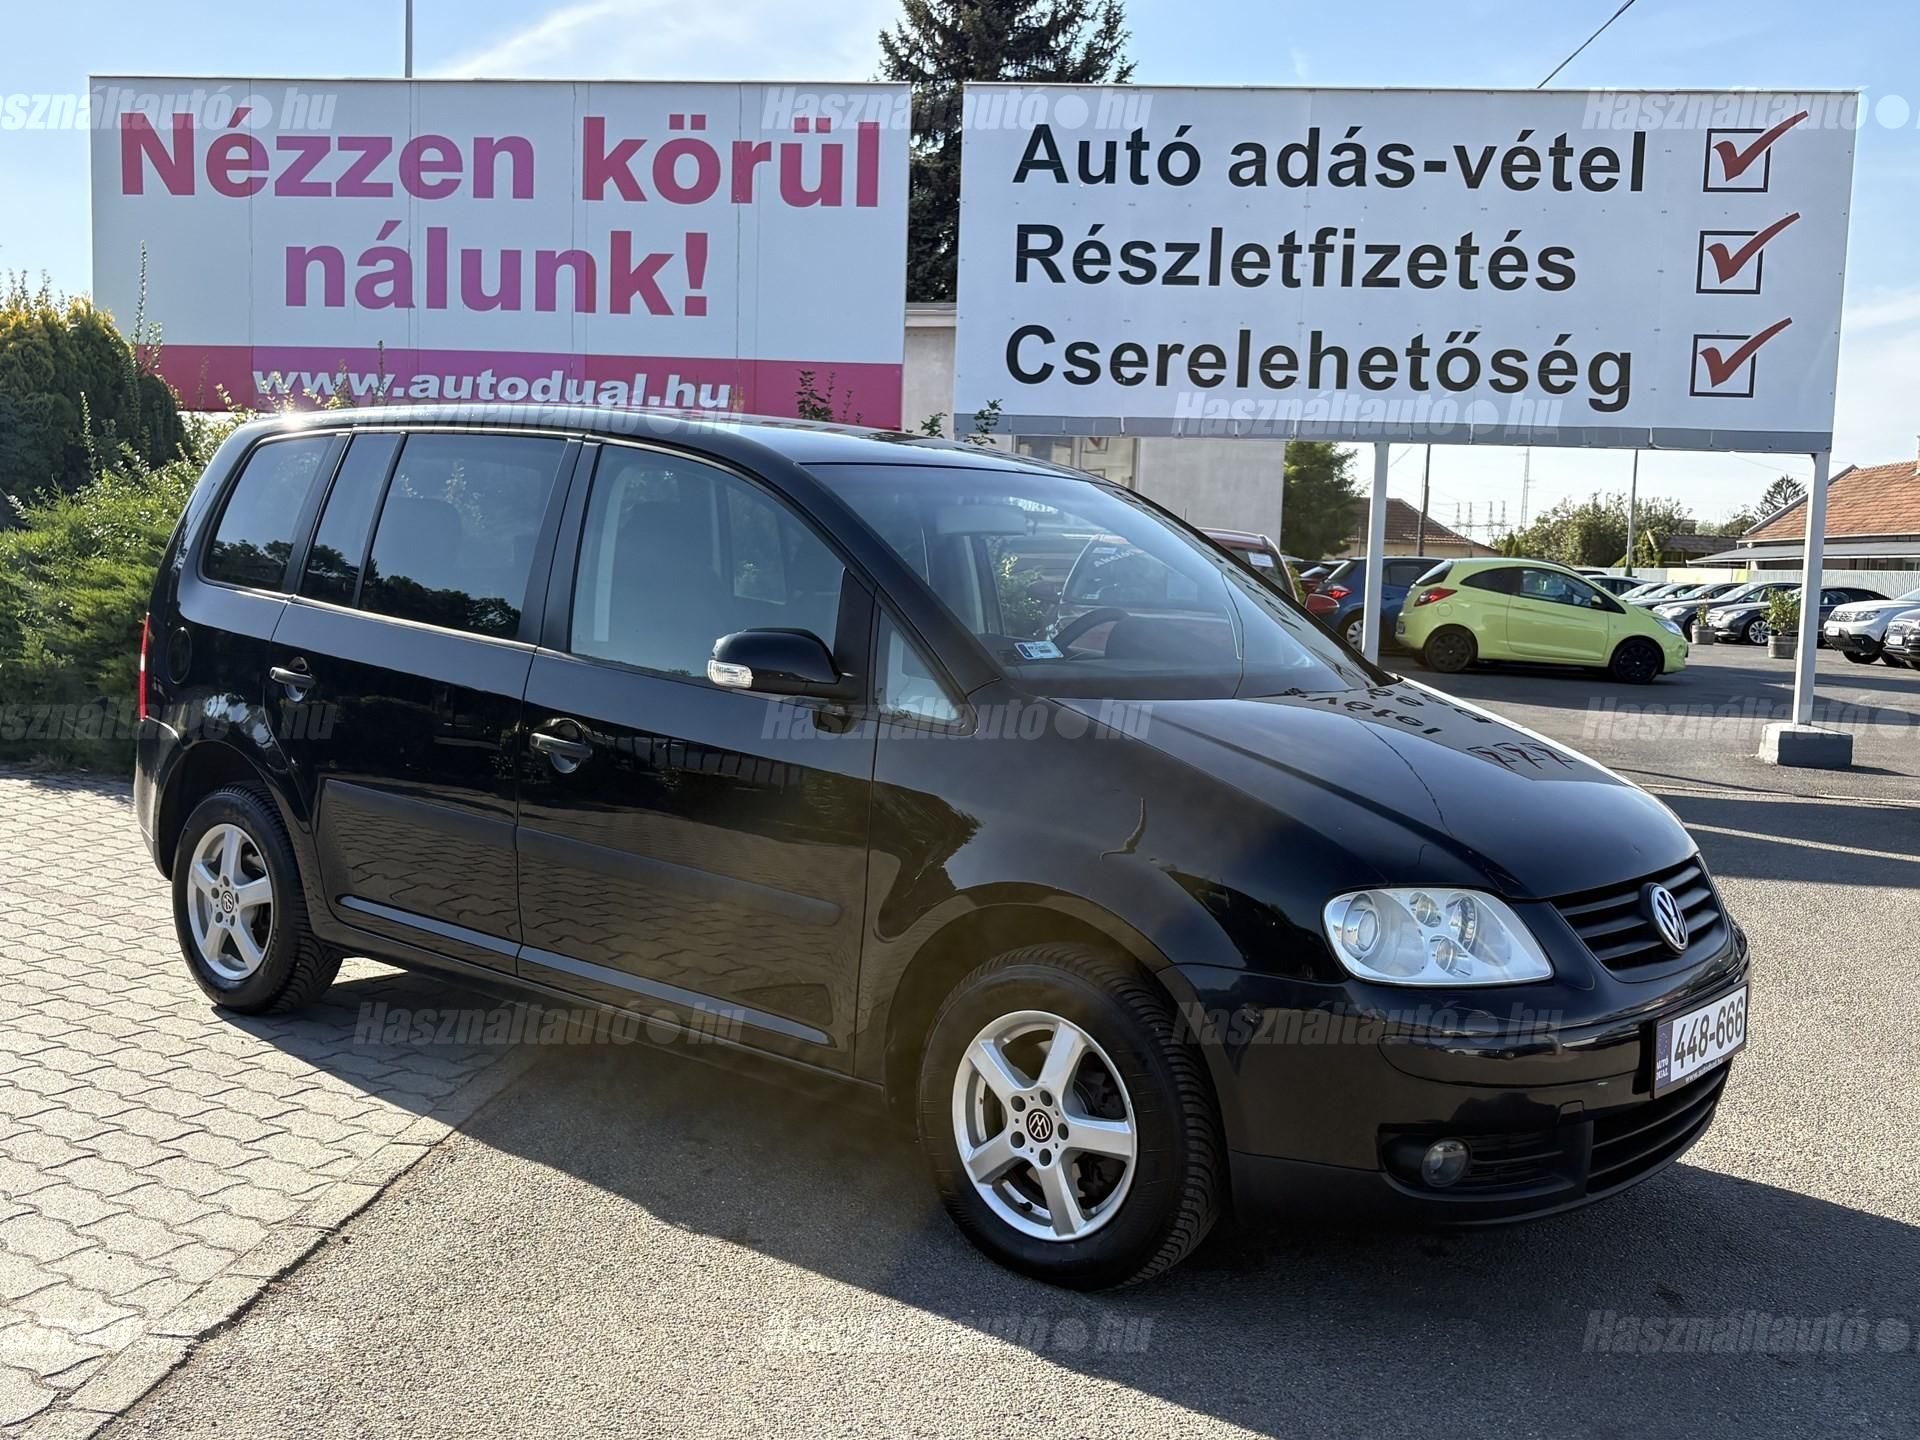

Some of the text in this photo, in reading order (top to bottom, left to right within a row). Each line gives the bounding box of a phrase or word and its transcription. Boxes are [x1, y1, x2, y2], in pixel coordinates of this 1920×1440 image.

[120, 107, 880, 207] Nézzen körül
[1012, 124, 1646, 193] Autó adás-vétel
[285, 220, 708, 316] nálunk!
[1015, 223, 1577, 292] Részletfizetés
[253, 369, 731, 408] www.autodual.hu
[1006, 324, 1631, 412] Cserelehetőség
[1674, 995, 1744, 1070] 448-666
